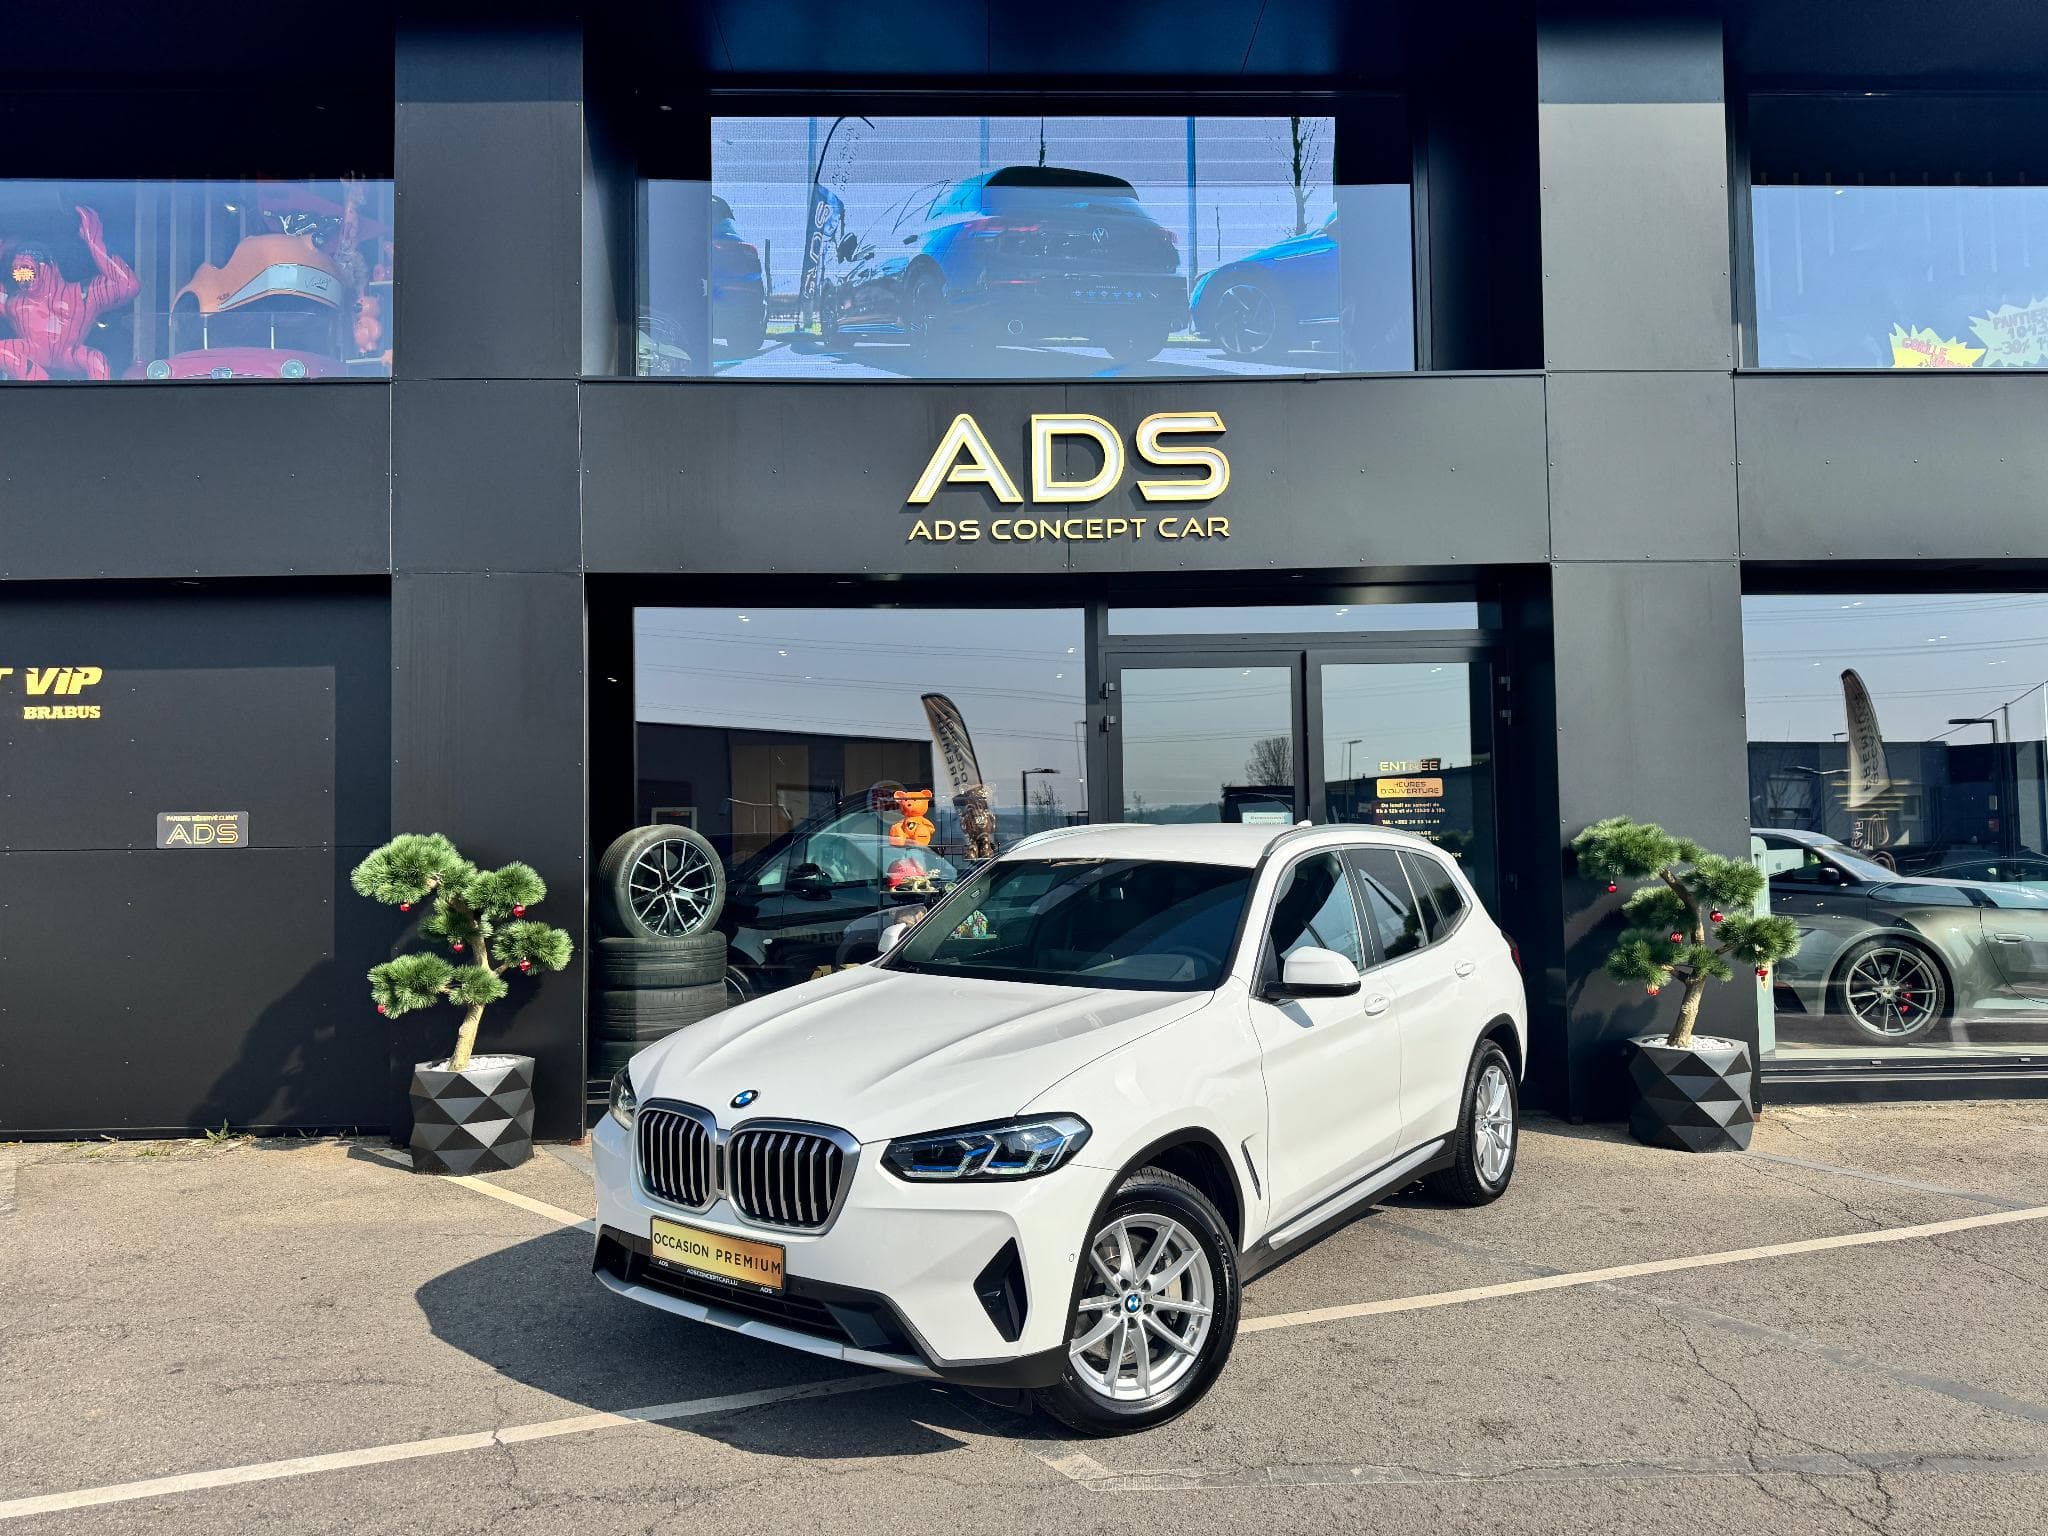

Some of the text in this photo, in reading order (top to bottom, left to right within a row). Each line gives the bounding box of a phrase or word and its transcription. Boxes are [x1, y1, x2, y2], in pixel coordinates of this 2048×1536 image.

[907, 411, 1230, 503] ADS
[908, 517, 1230, 541] ADS CONCEPT CAR
[23, 705, 101, 720] BRABUS
[165, 823, 239, 845] ADS
[653, 1232, 781, 1275] OCCASION PREMIUM
